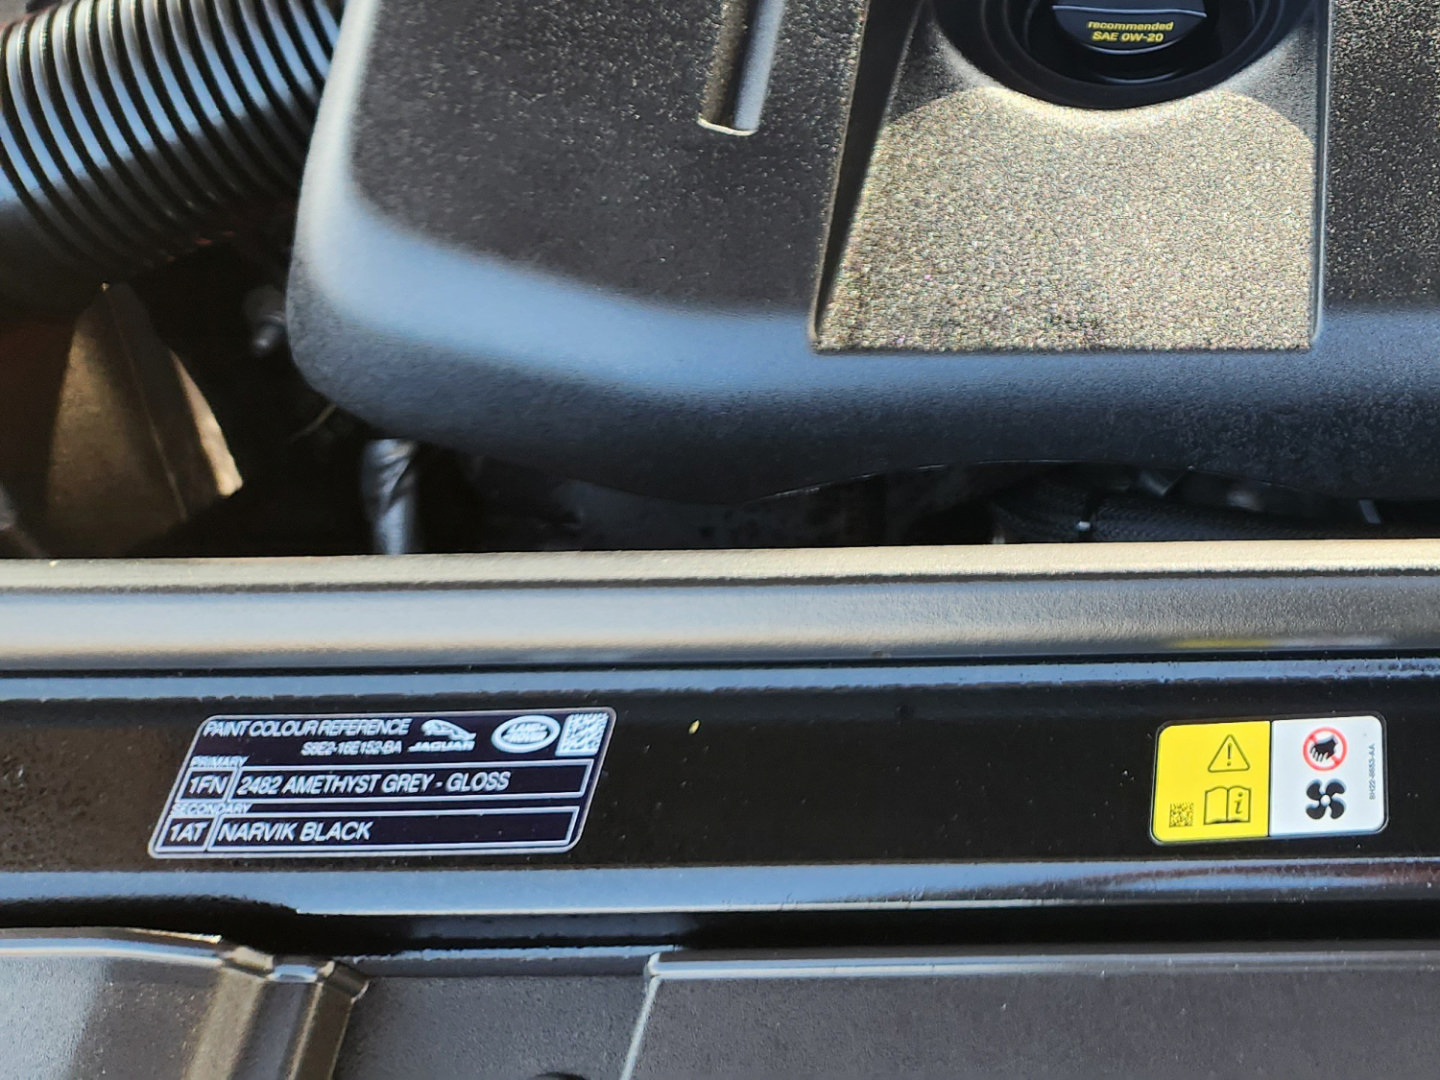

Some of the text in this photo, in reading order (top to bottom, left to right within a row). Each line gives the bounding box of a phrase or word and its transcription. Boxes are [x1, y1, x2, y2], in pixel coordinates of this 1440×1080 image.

[1087, 21, 1174, 32] recommended
[1092, 31, 1164, 43] SAE 0W-20
[204, 718, 412, 737] PAINT COLOUR REFERENCE
[407, 740, 476, 752] JAGUAR
[190, 756, 249, 767] PRIMARY
[189, 775, 228, 794] 1FN
[236, 775, 282, 795] 2482
[281, 774, 381, 794] AMETHYST
[381, 773, 435, 793] GREY
[445, 771, 511, 792] GLOSS
[171, 803, 252, 815] SECONDARY
[169, 821, 373, 842] 1AT NARVIK BLACK
